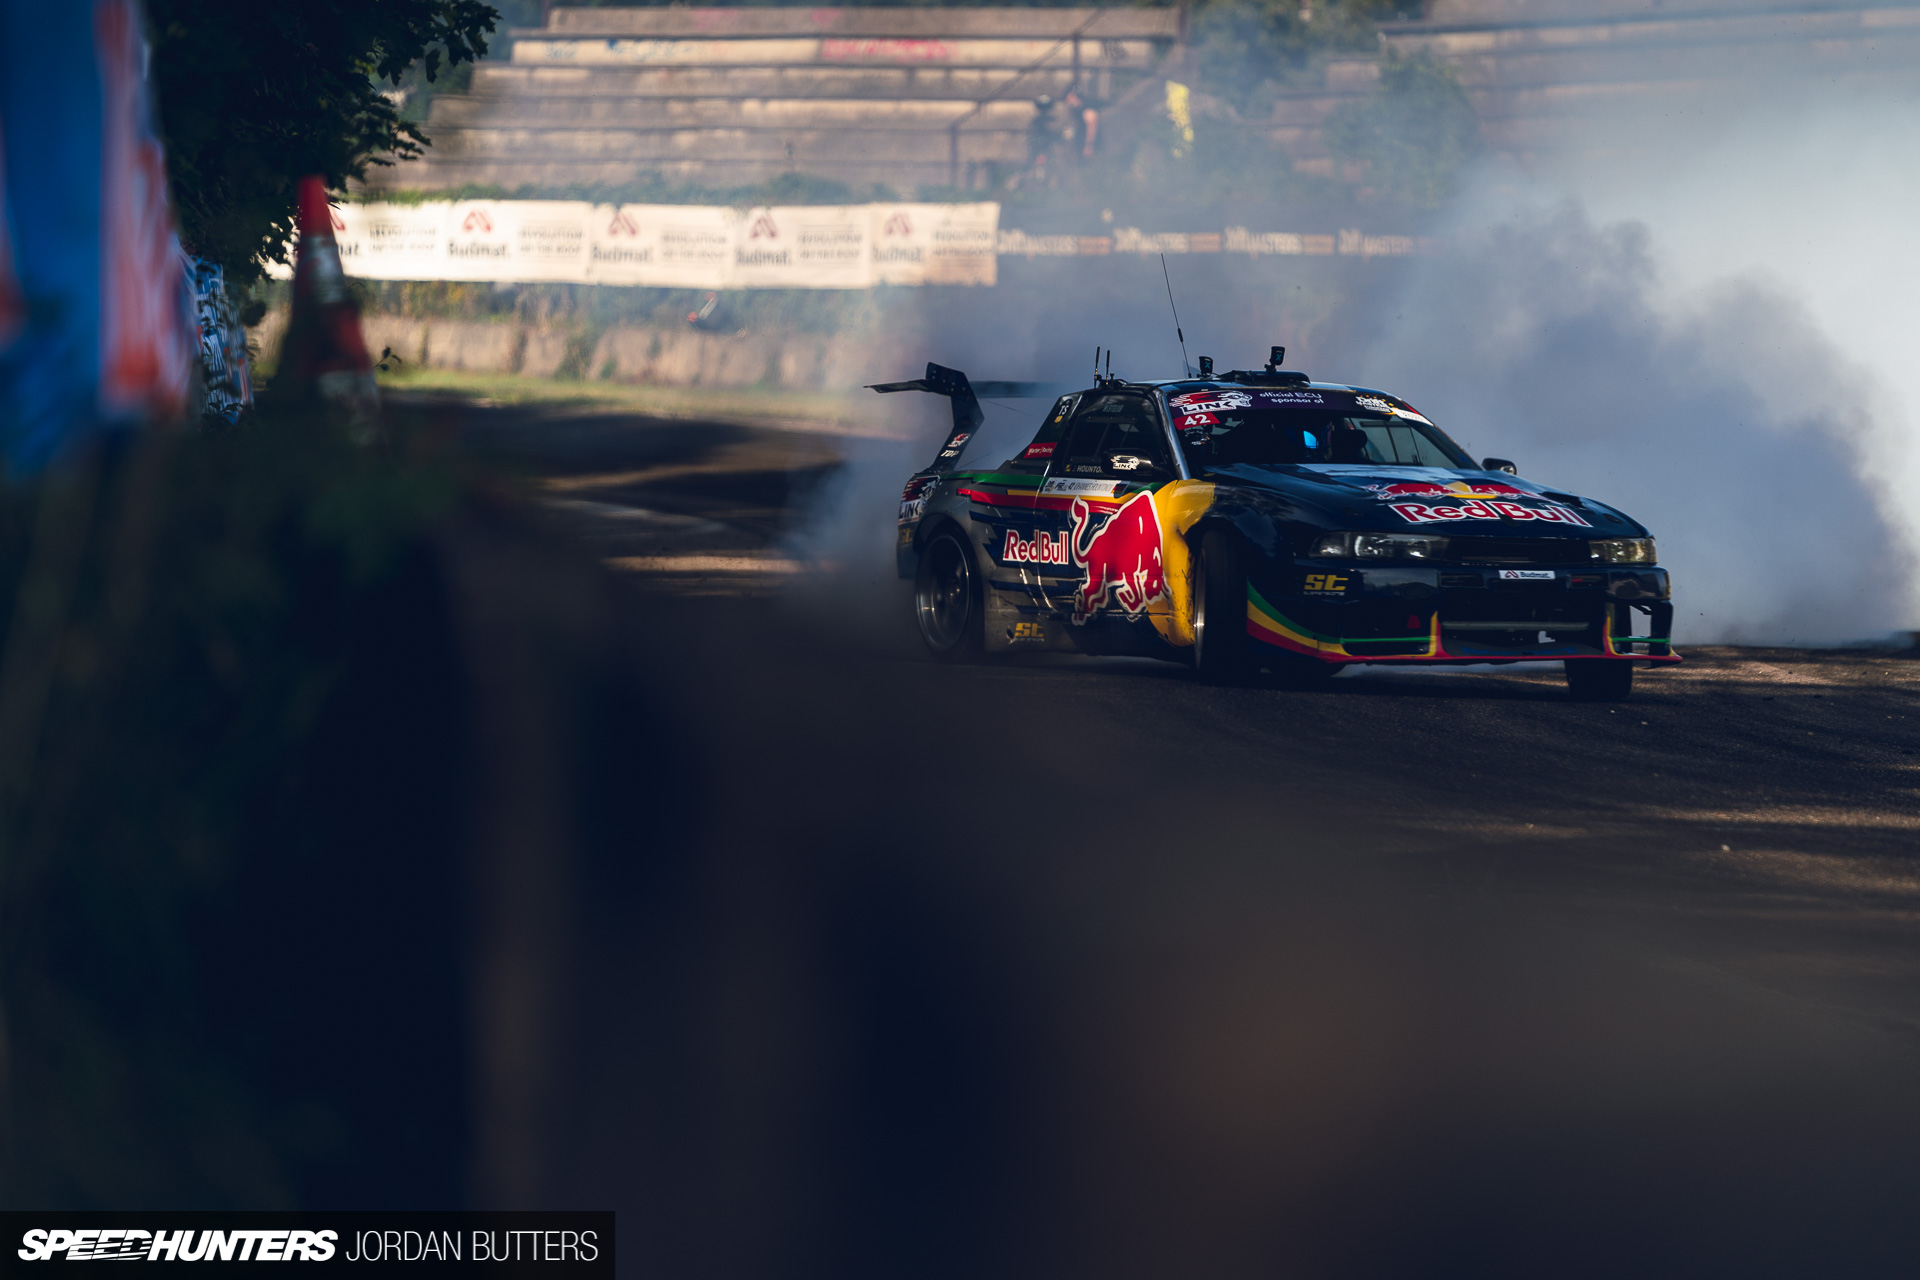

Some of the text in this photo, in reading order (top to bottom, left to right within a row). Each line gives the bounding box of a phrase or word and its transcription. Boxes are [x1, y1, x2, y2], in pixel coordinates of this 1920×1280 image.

[1181, 401, 1236, 414] LINK
[1184, 414, 1211, 426] 42
[1304, 574, 1349, 591] st
[1014, 622, 1044, 638] st
